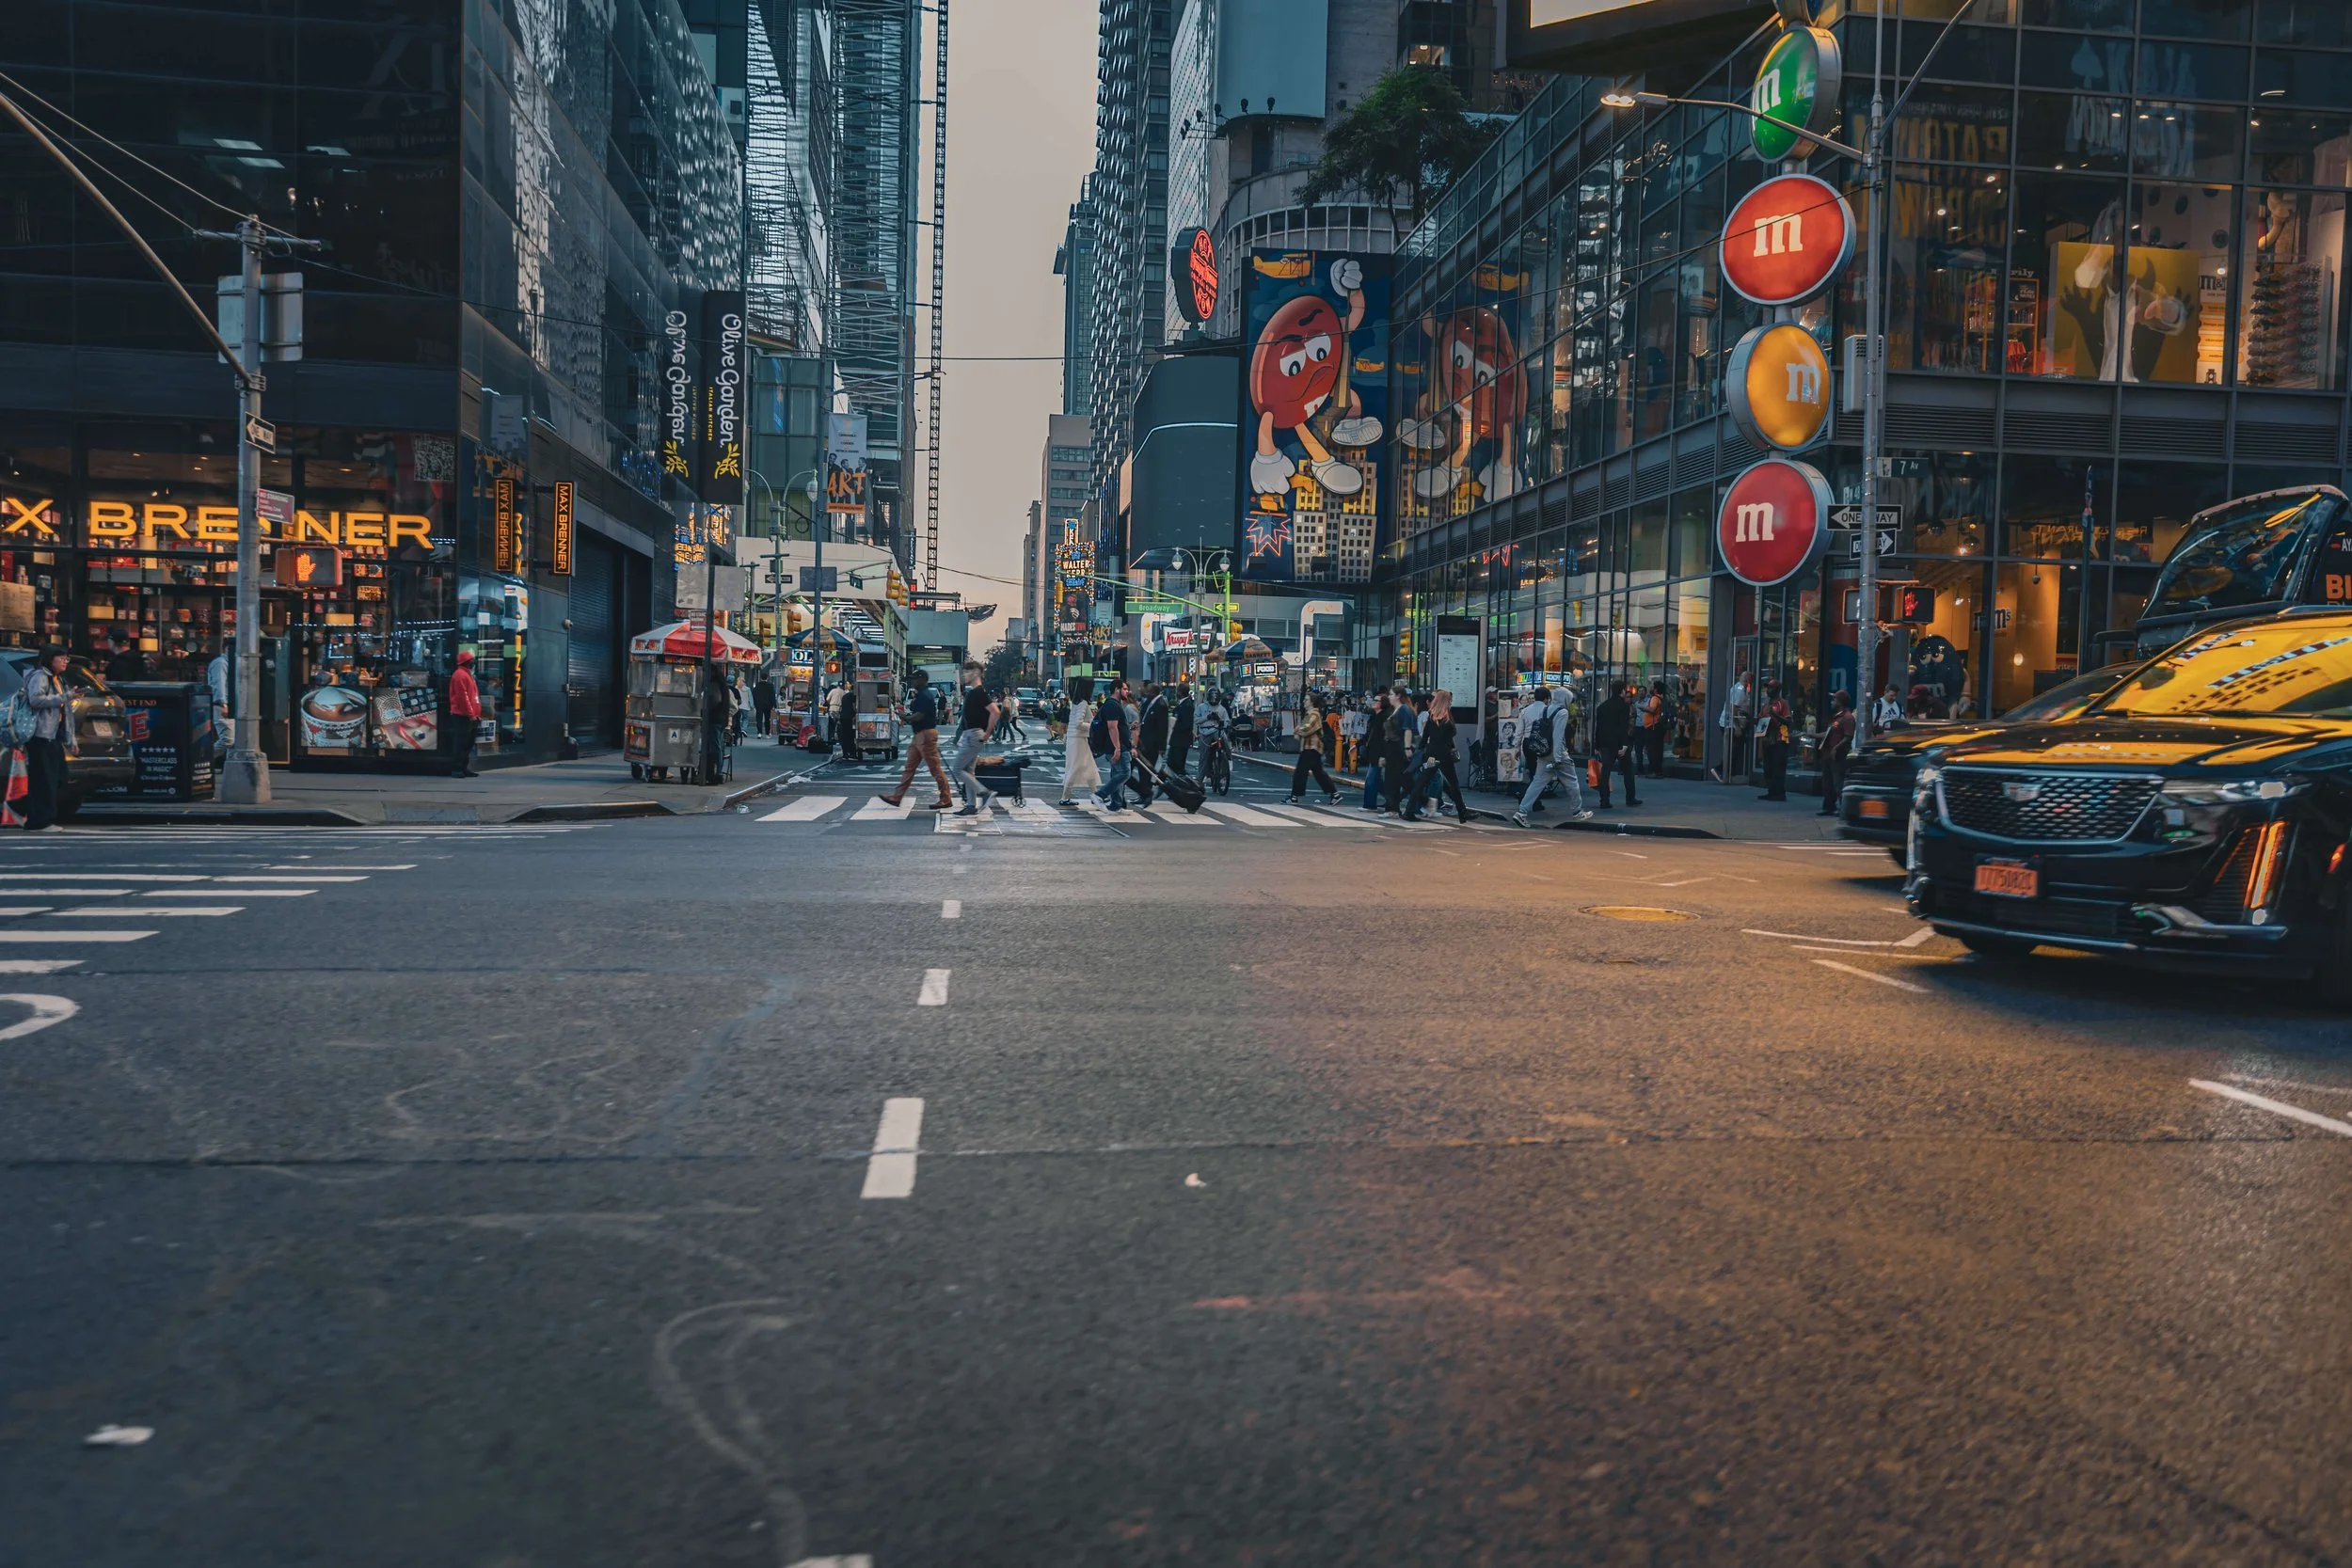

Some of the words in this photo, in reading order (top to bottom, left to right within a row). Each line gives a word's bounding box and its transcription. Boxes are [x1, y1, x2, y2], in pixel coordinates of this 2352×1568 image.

[1754, 69, 1782, 116] m
[1753, 213, 1804, 258] m
[721, 312, 741, 366] Olive
[1787, 362, 1821, 404] m
[717, 368, 740, 448] Garden
[827, 471, 866, 498] ART
[1899, 461, 1907, 475] 7
[1910, 461, 1919, 470] Av
[557, 485, 570, 514] MAX
[89, 500, 435, 550] BRENER
[1736, 501, 1774, 543] m
[1841, 513, 1861, 523] ONE
[557, 515, 570, 571] BRENNER
[1063, 559, 1089, 570] WALTER
[1138, 603, 1170, 613] Broadway
[1166, 630, 1188, 647] Krispy
[1256, 665, 1275, 673] FOOD
